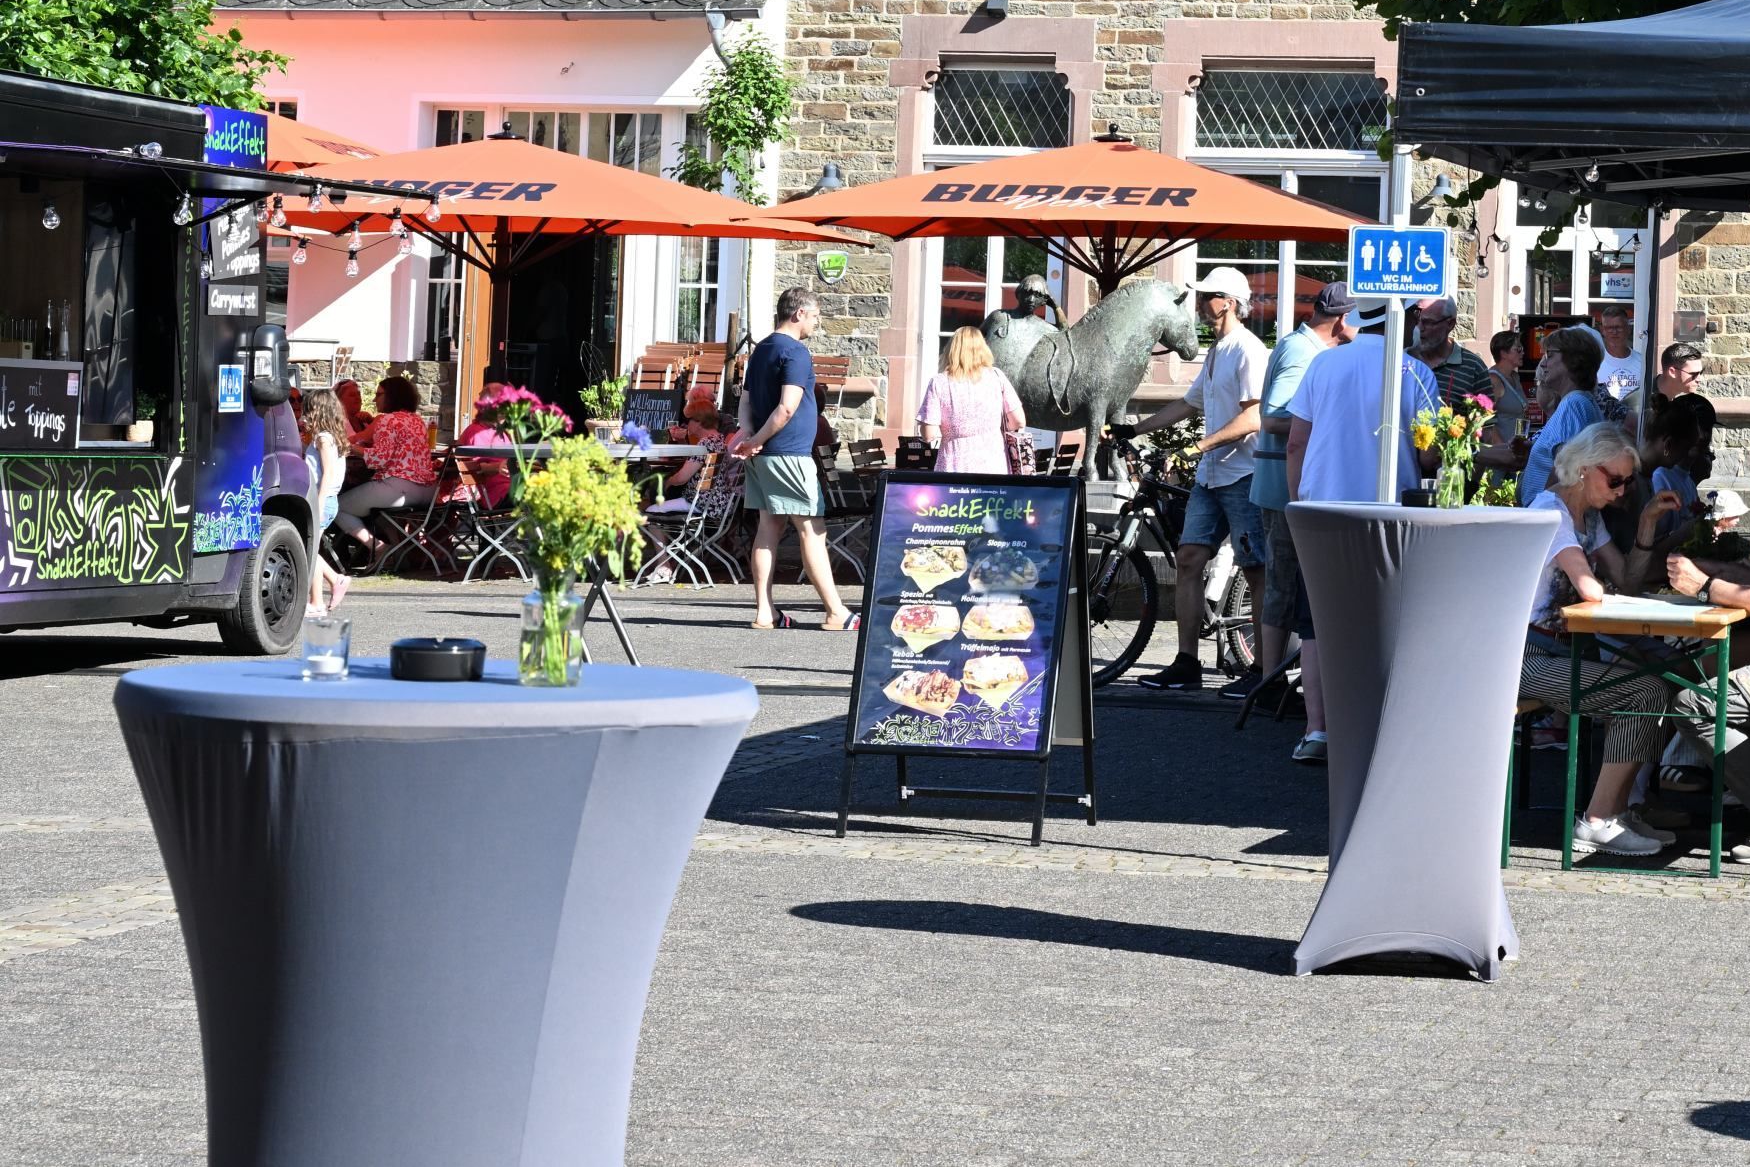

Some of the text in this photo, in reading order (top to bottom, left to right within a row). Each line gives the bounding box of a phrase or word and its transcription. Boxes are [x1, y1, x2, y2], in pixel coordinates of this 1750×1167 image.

[920, 183, 1198, 207] BURGER
[996, 194, 1119, 210] Werk
[1382, 274, 1399, 282] WC
[1605, 278, 1621, 287] vhs
[1357, 281, 1439, 292] KULTURBAHNHOF
[211, 289, 257, 314] Currywurst
[29, 375, 42, 396] mit
[25, 403, 66, 442] Toppings
[916, 497, 1036, 524] SnackEffekt
[912, 523, 983, 535] PommesEffekt
[905, 537, 965, 547] Champignonrahm
[986, 538, 1027, 548] Sloppy BBQ
[37, 542, 120, 580] SnackEffekt
